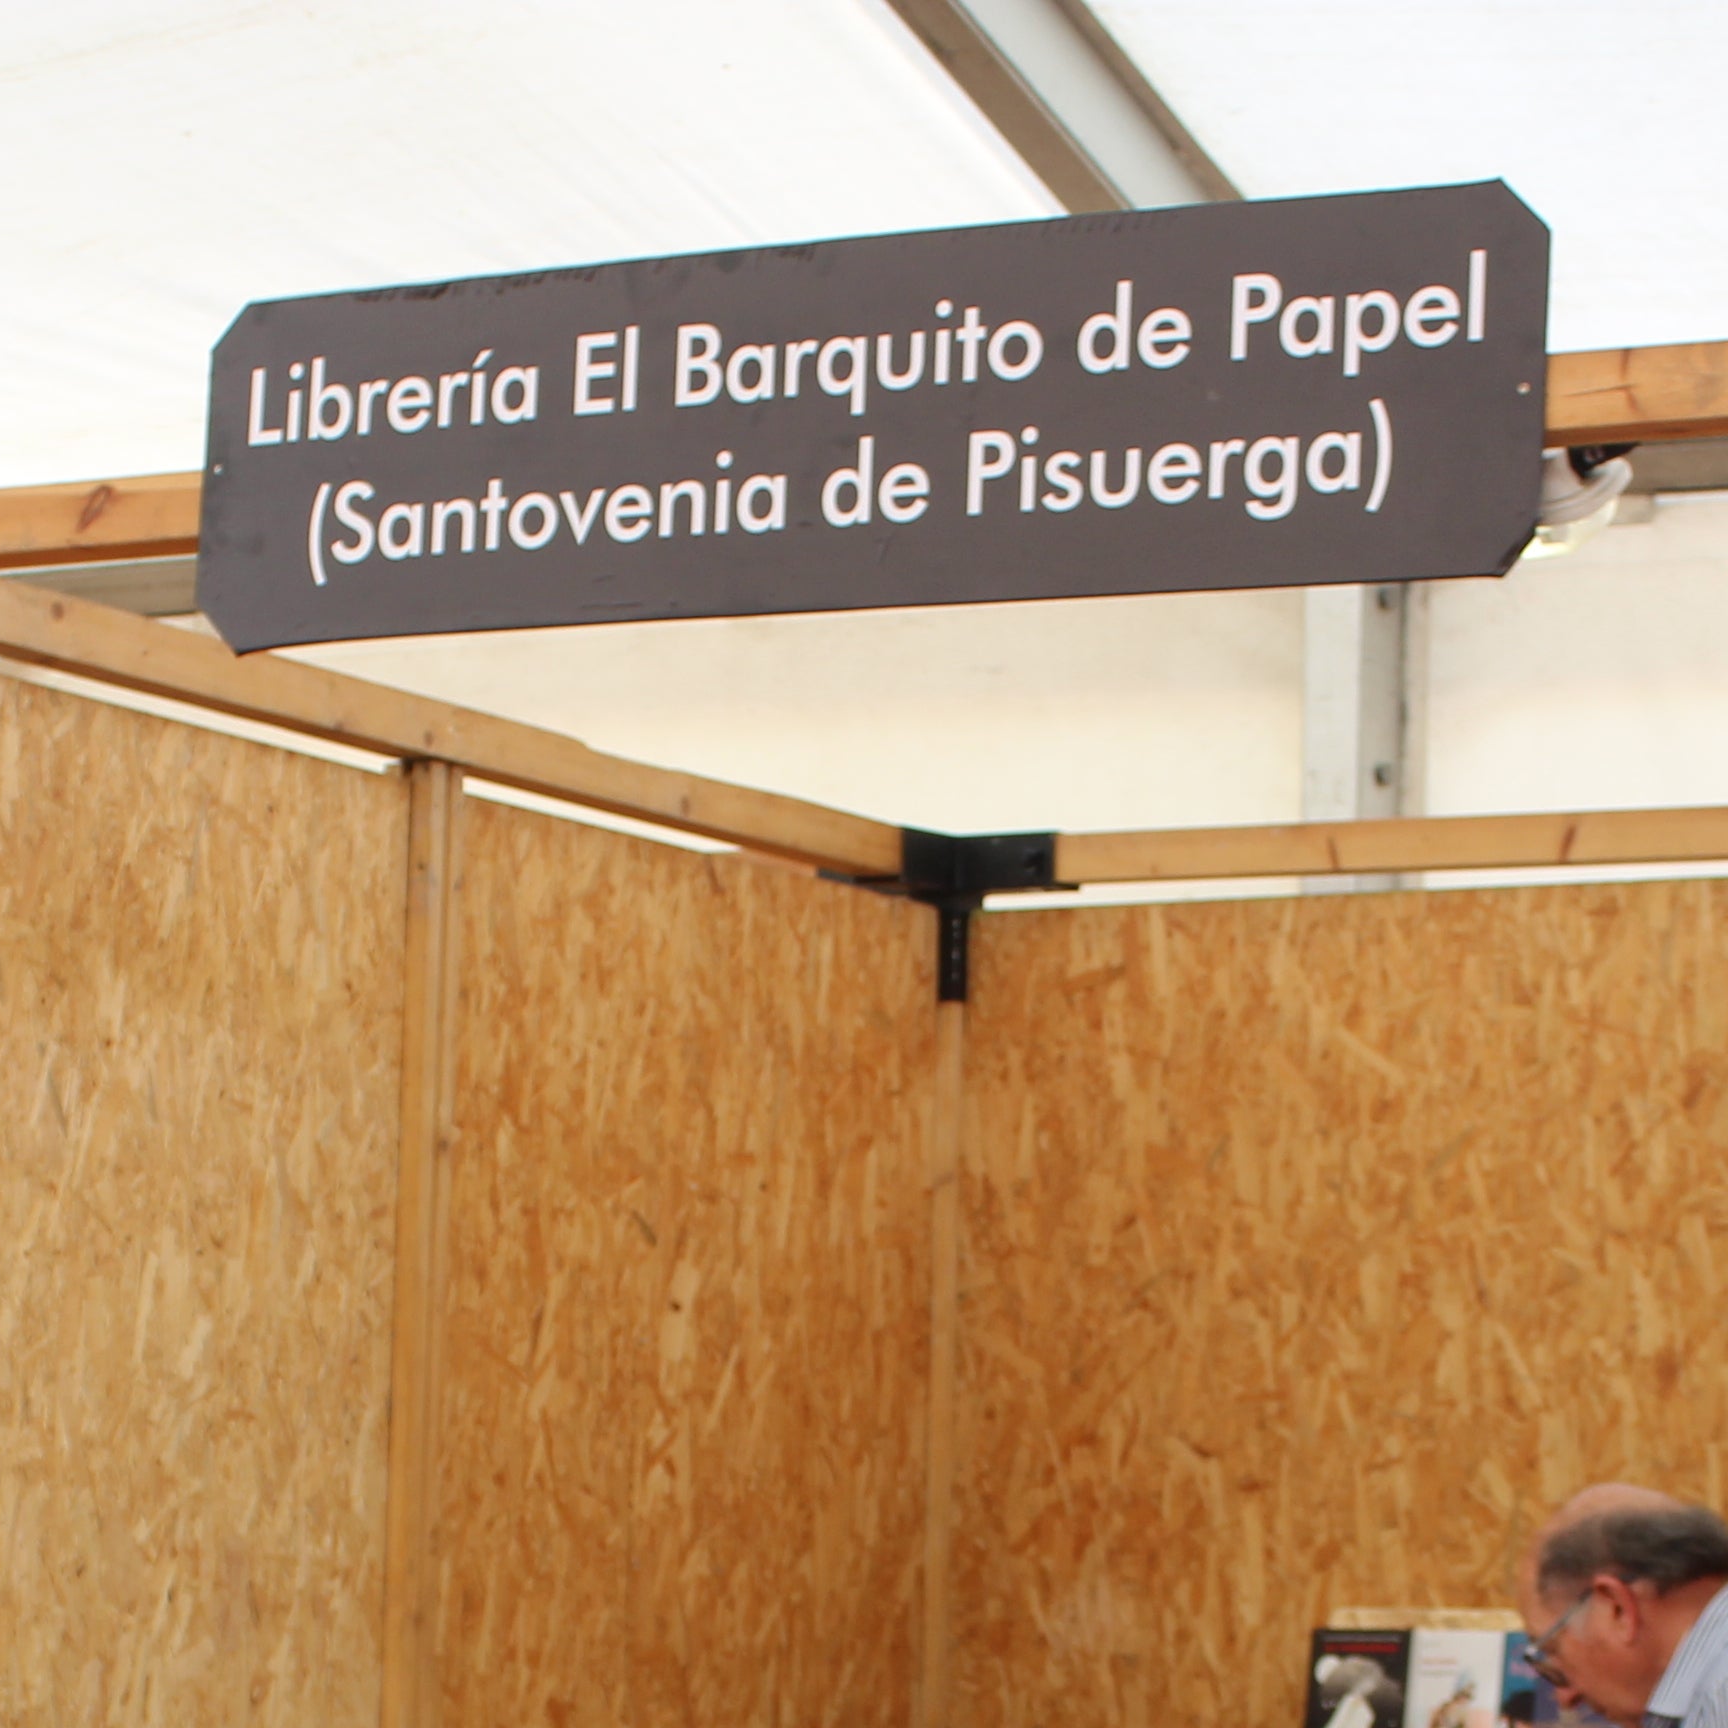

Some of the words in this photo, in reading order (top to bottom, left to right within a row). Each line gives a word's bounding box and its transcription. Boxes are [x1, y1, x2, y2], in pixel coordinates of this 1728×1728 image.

[248, 349, 539, 446] Librería
[573, 325, 639, 415] El
[674, 299, 1043, 415] Barquito
[1077, 280, 1192, 373] de
[1230, 249, 1486, 377] Papel
[308, 450, 787, 586] (Santovenia
[821, 436, 930, 527] de
[966, 398, 1392, 520] Pisuerga)
